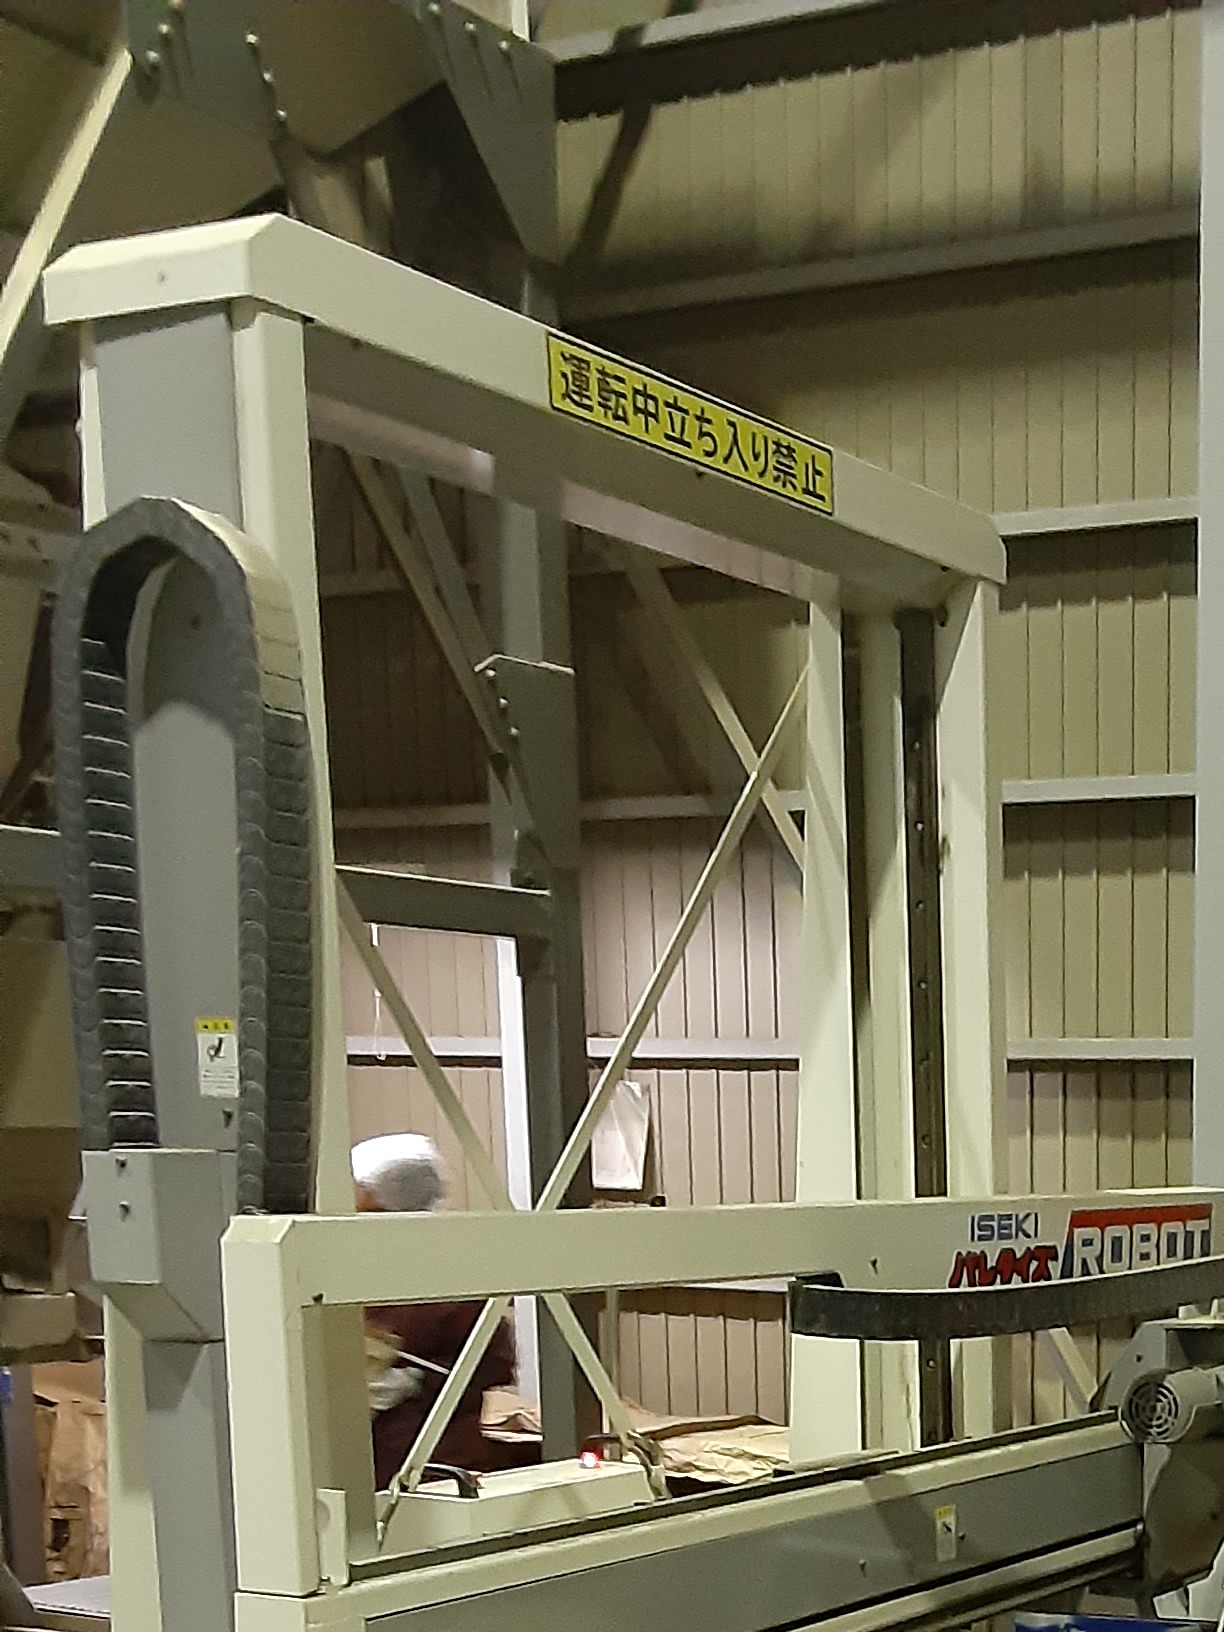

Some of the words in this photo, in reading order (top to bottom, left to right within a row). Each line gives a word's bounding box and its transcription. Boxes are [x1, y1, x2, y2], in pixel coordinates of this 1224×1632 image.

[560, 350, 827, 503] 運転中立ち入り禁止
[970, 1212, 1039, 1242] ISEKI
[1074, 1219, 1210, 1278] ROBOT
